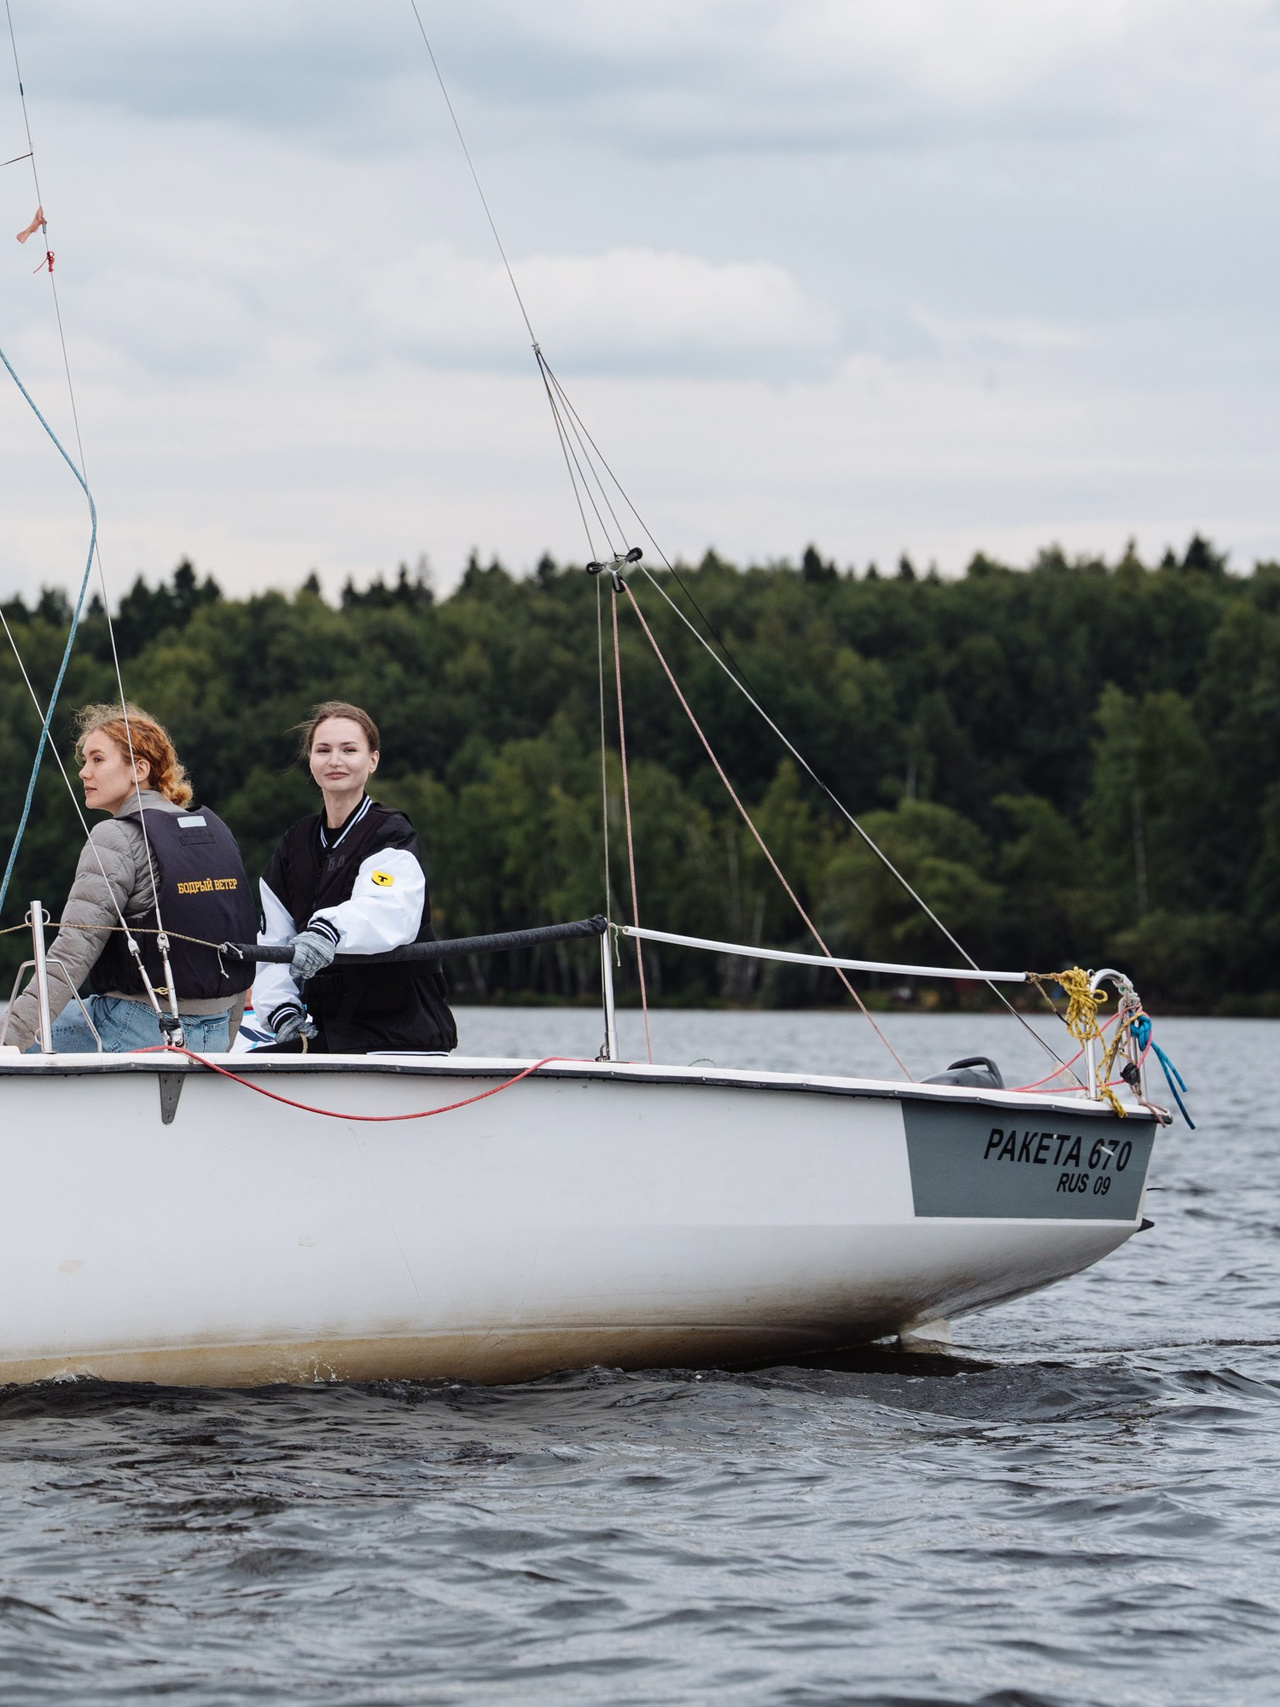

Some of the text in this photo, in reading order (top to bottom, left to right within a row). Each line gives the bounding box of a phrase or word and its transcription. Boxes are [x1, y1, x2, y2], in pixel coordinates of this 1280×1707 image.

[177, 878, 238, 895] БОДРЫЙ ВЕТЕР
[983, 1128, 1133, 1172] РАКЕТА 670
[1056, 1172, 1111, 1196] RUS 09
